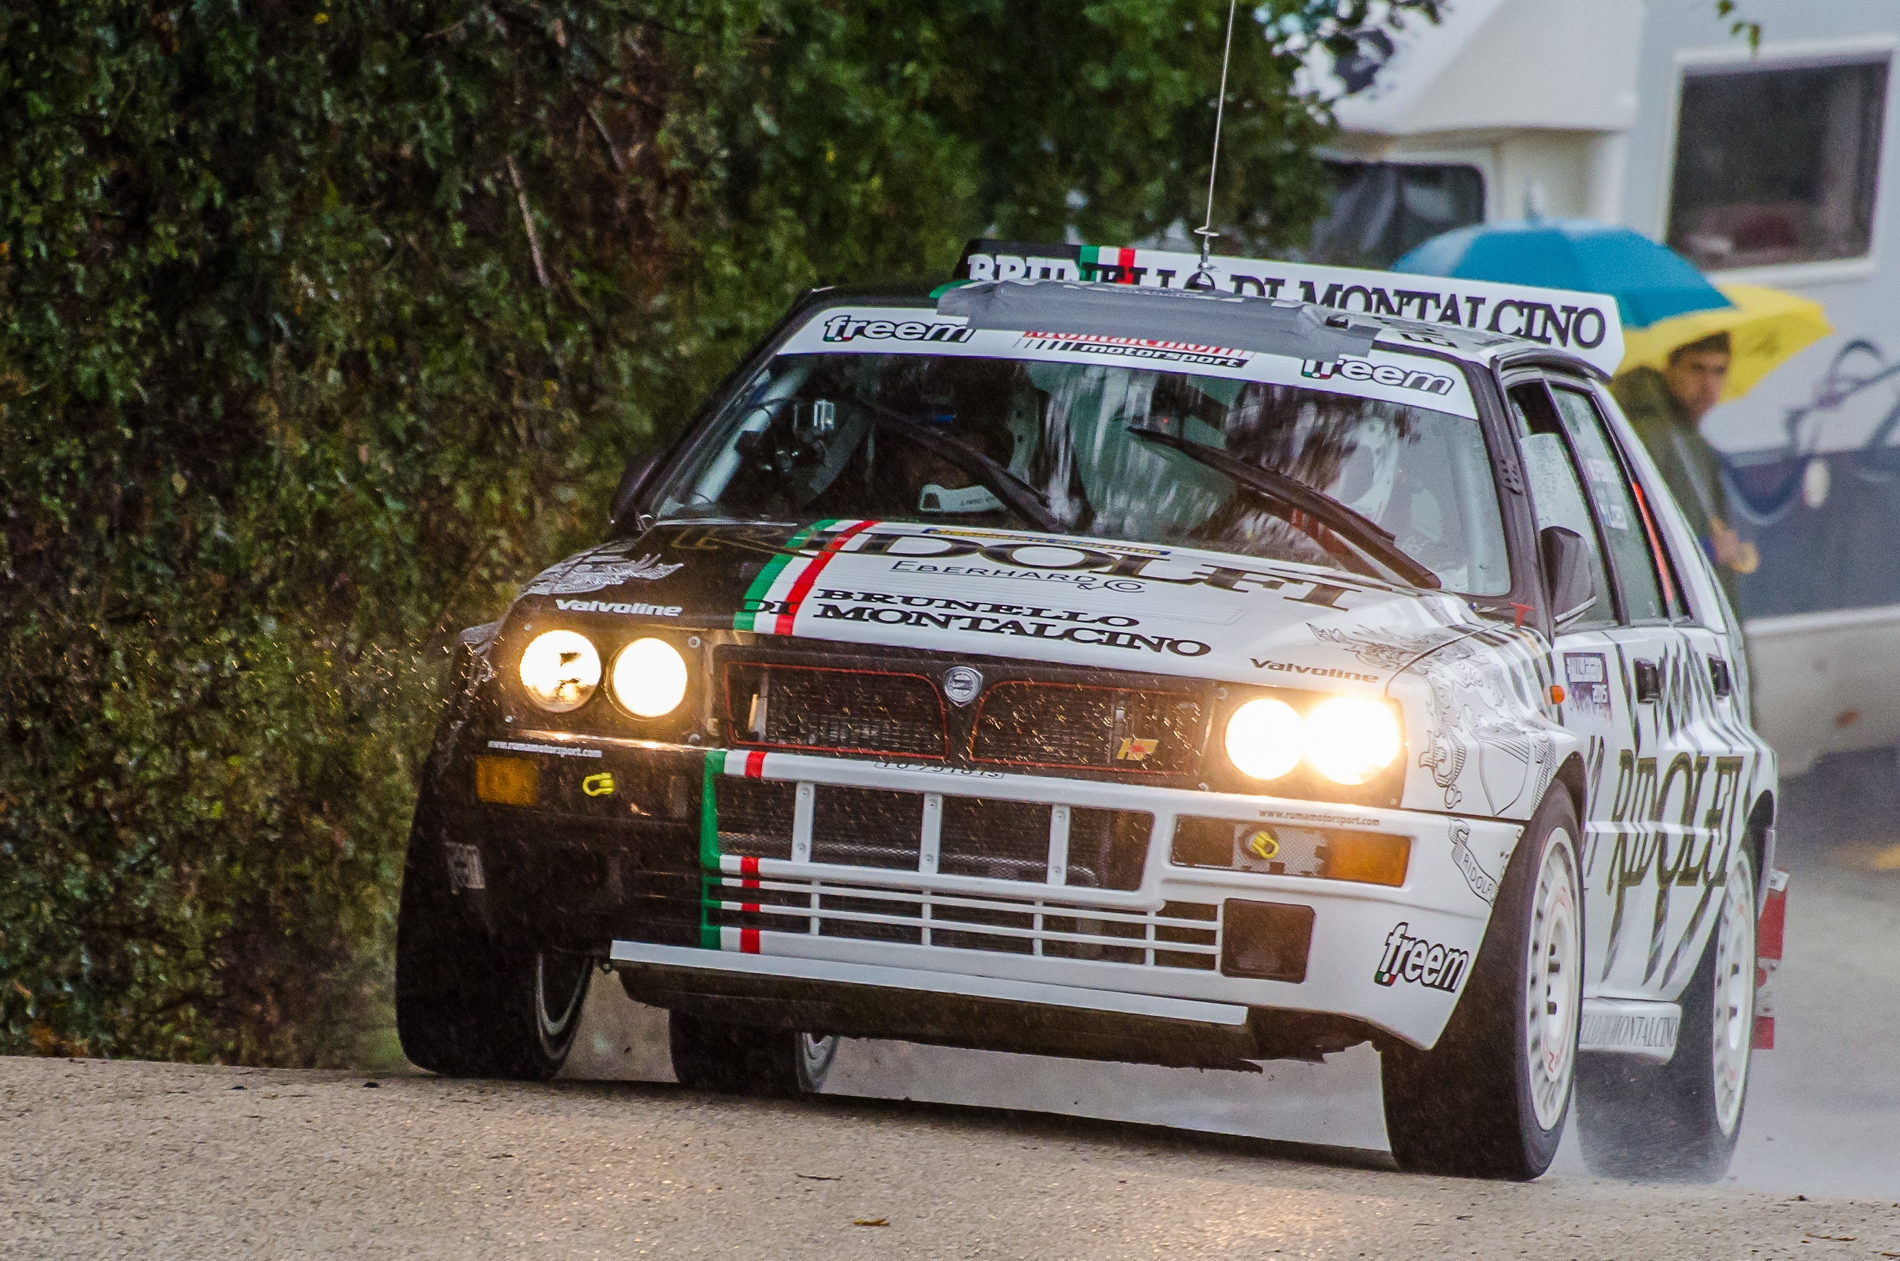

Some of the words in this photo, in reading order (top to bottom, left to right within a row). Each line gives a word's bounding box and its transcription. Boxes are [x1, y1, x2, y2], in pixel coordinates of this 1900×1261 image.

[823, 315, 976, 343] freem
[1081, 343, 1239, 367] motorsport
[890, 558, 1097, 582] EBERHARD
[556, 599, 683, 617] Valvoline
[814, 588, 1140, 627] BRUNELLO
[744, 600, 798, 616] DI
[812, 603, 1211, 657] MONTALCINO
[1250, 658, 1379, 684] Valvoline
[1258, 810, 1380, 826] www.rumamotorsport.com
[1374, 921, 1470, 993] freem
